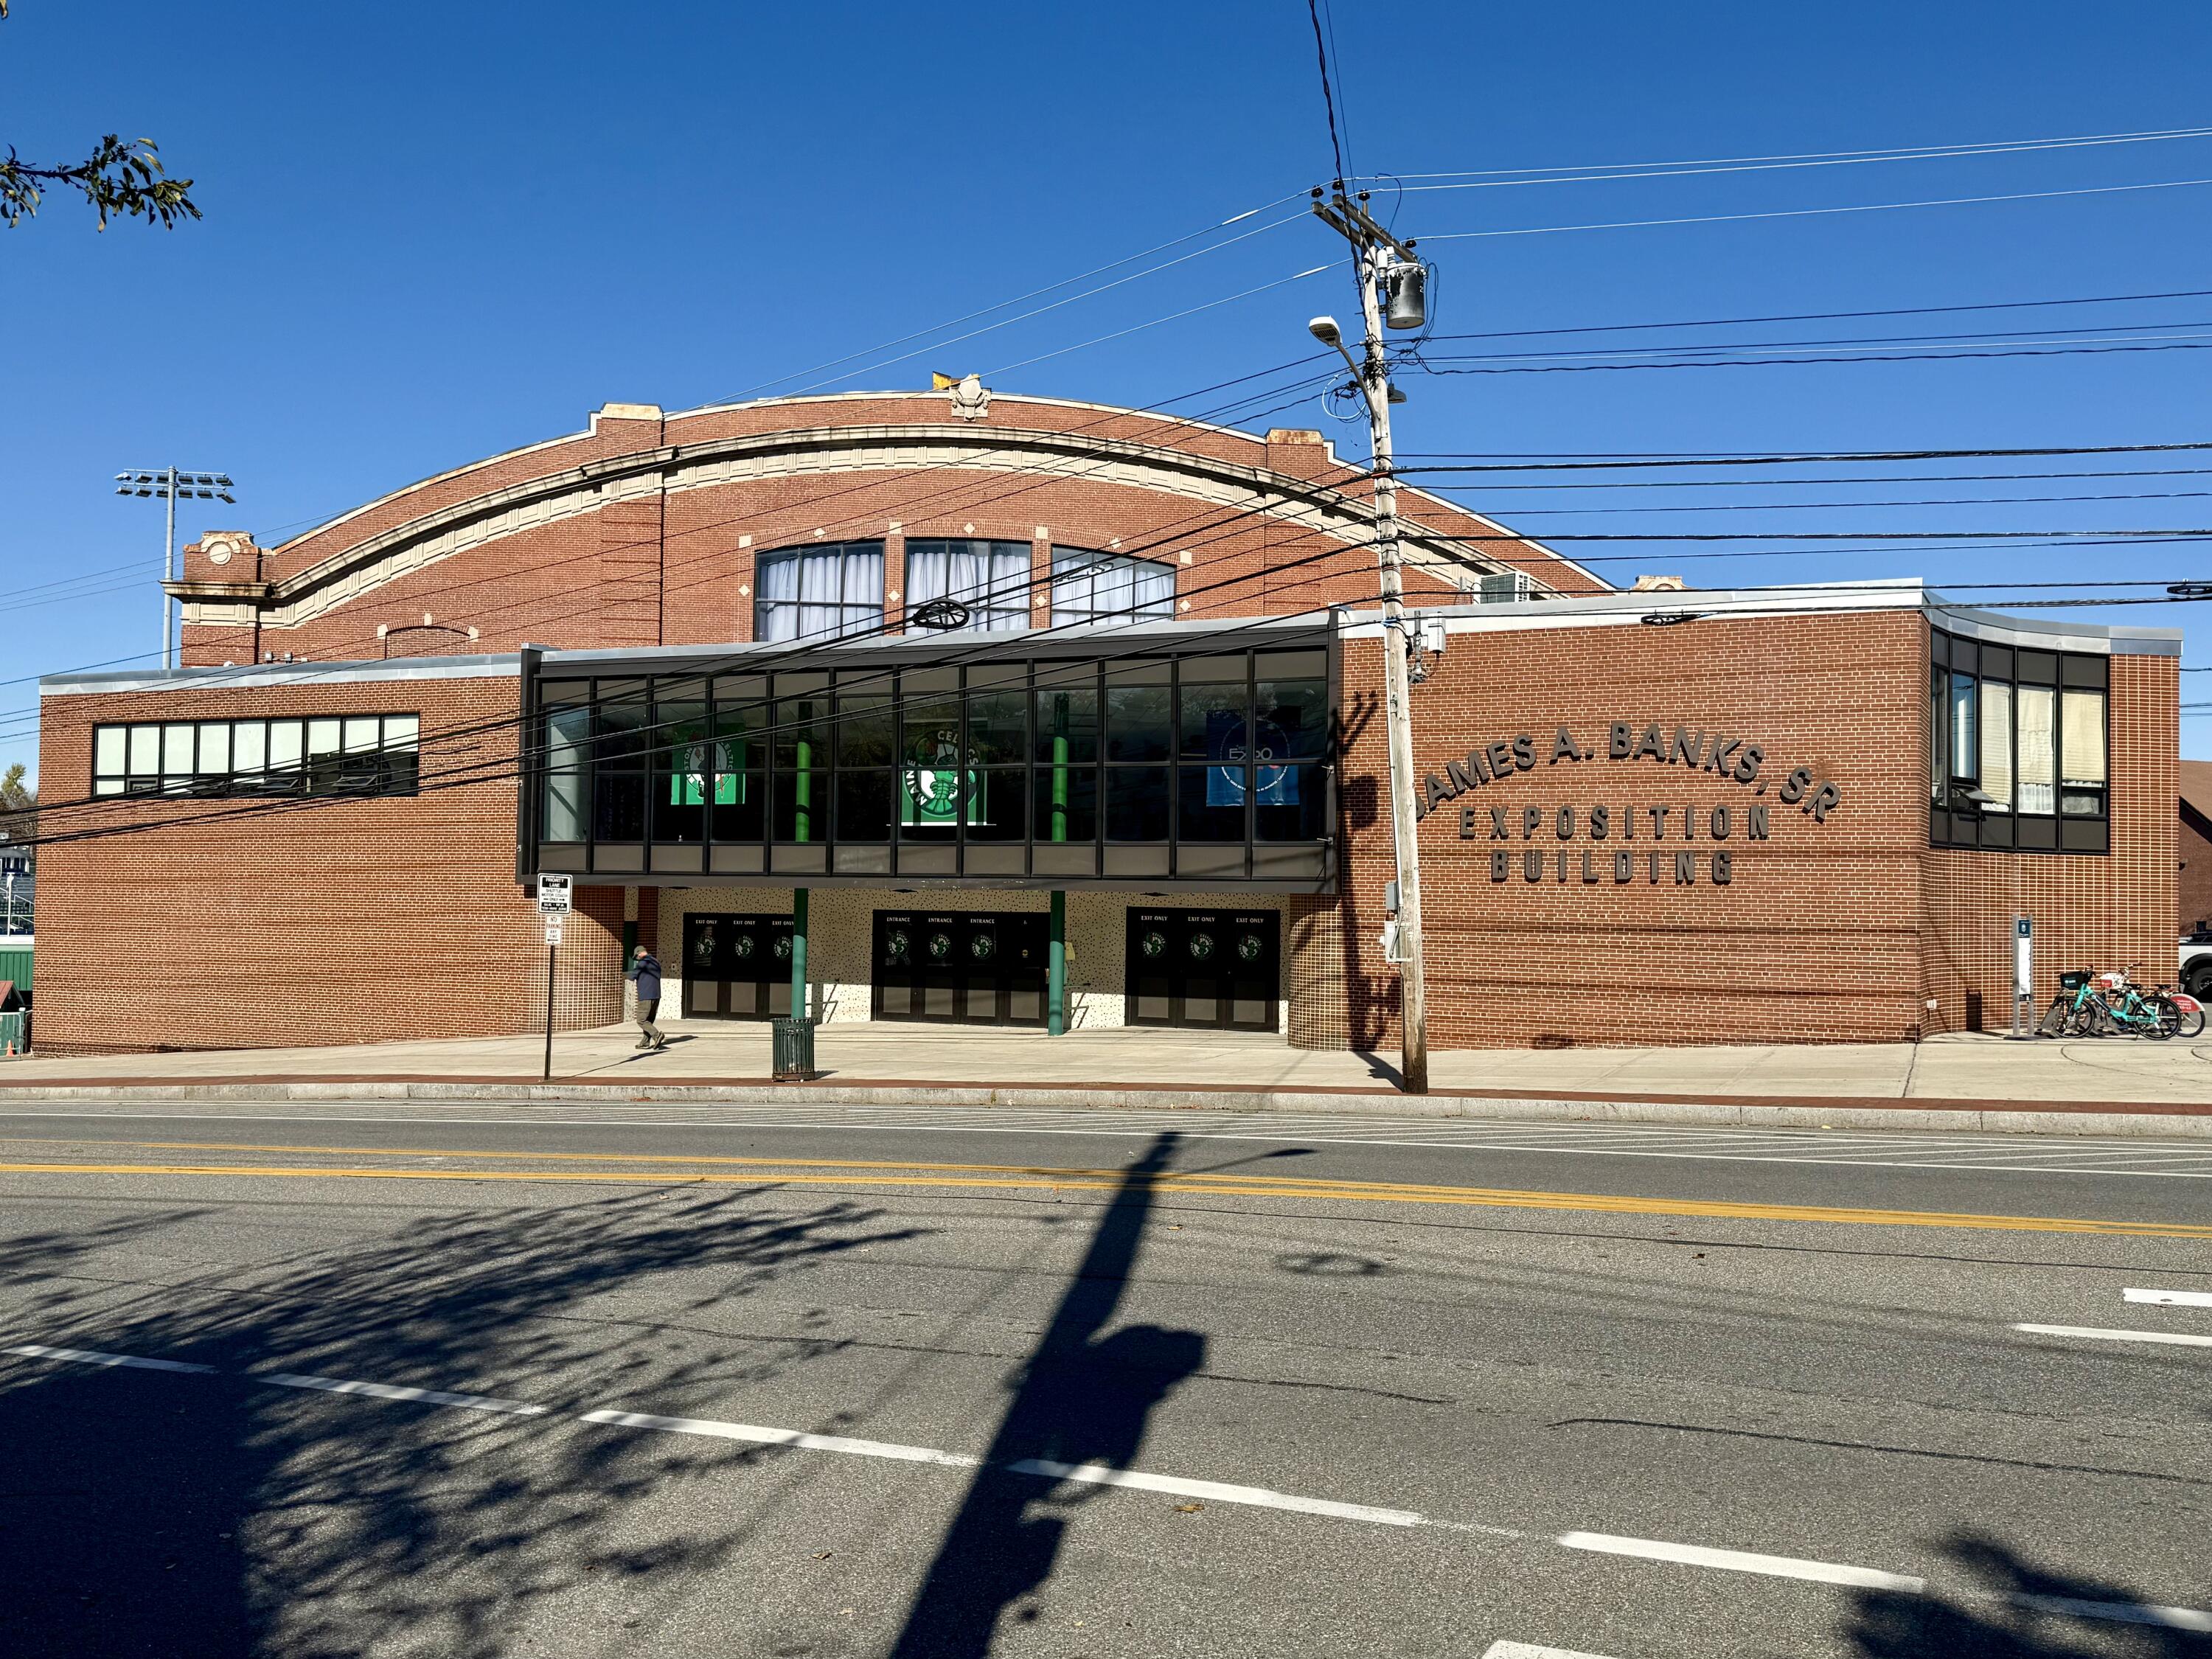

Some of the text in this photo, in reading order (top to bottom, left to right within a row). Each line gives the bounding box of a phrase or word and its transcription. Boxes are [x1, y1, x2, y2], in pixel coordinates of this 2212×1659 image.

[905, 759, 928, 806] MAINE
[1549, 726, 1594, 765] A.
[1610, 720, 1770, 796] BANKS,
[1779, 765, 1842, 824] SR
[1460, 804, 1770, 841] EXPOSITION
[1492, 849, 1732, 886] BUILDING
